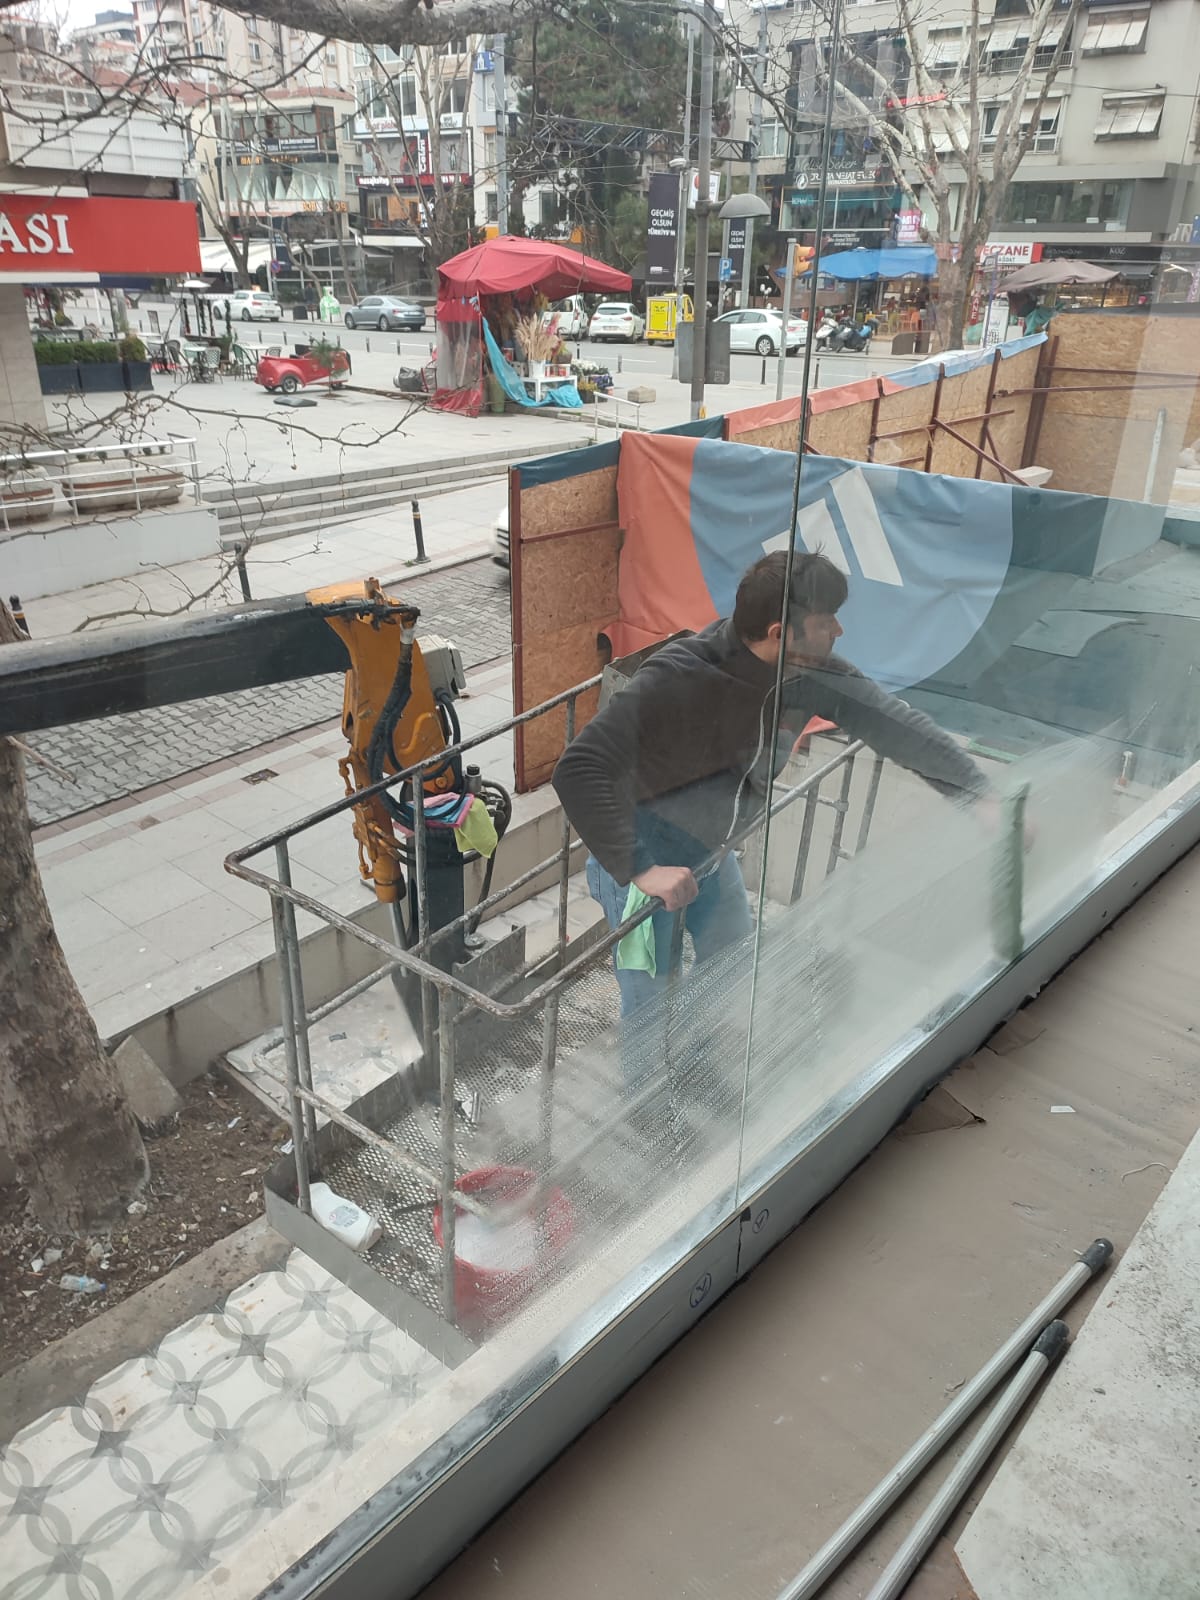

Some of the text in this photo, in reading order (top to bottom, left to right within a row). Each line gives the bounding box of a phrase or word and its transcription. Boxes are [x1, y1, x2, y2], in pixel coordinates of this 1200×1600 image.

[650, 208, 675, 218] GEÇMİŞ
[983, 245, 1030, 256] ECZANE
[721, 259, 730, 272] P
